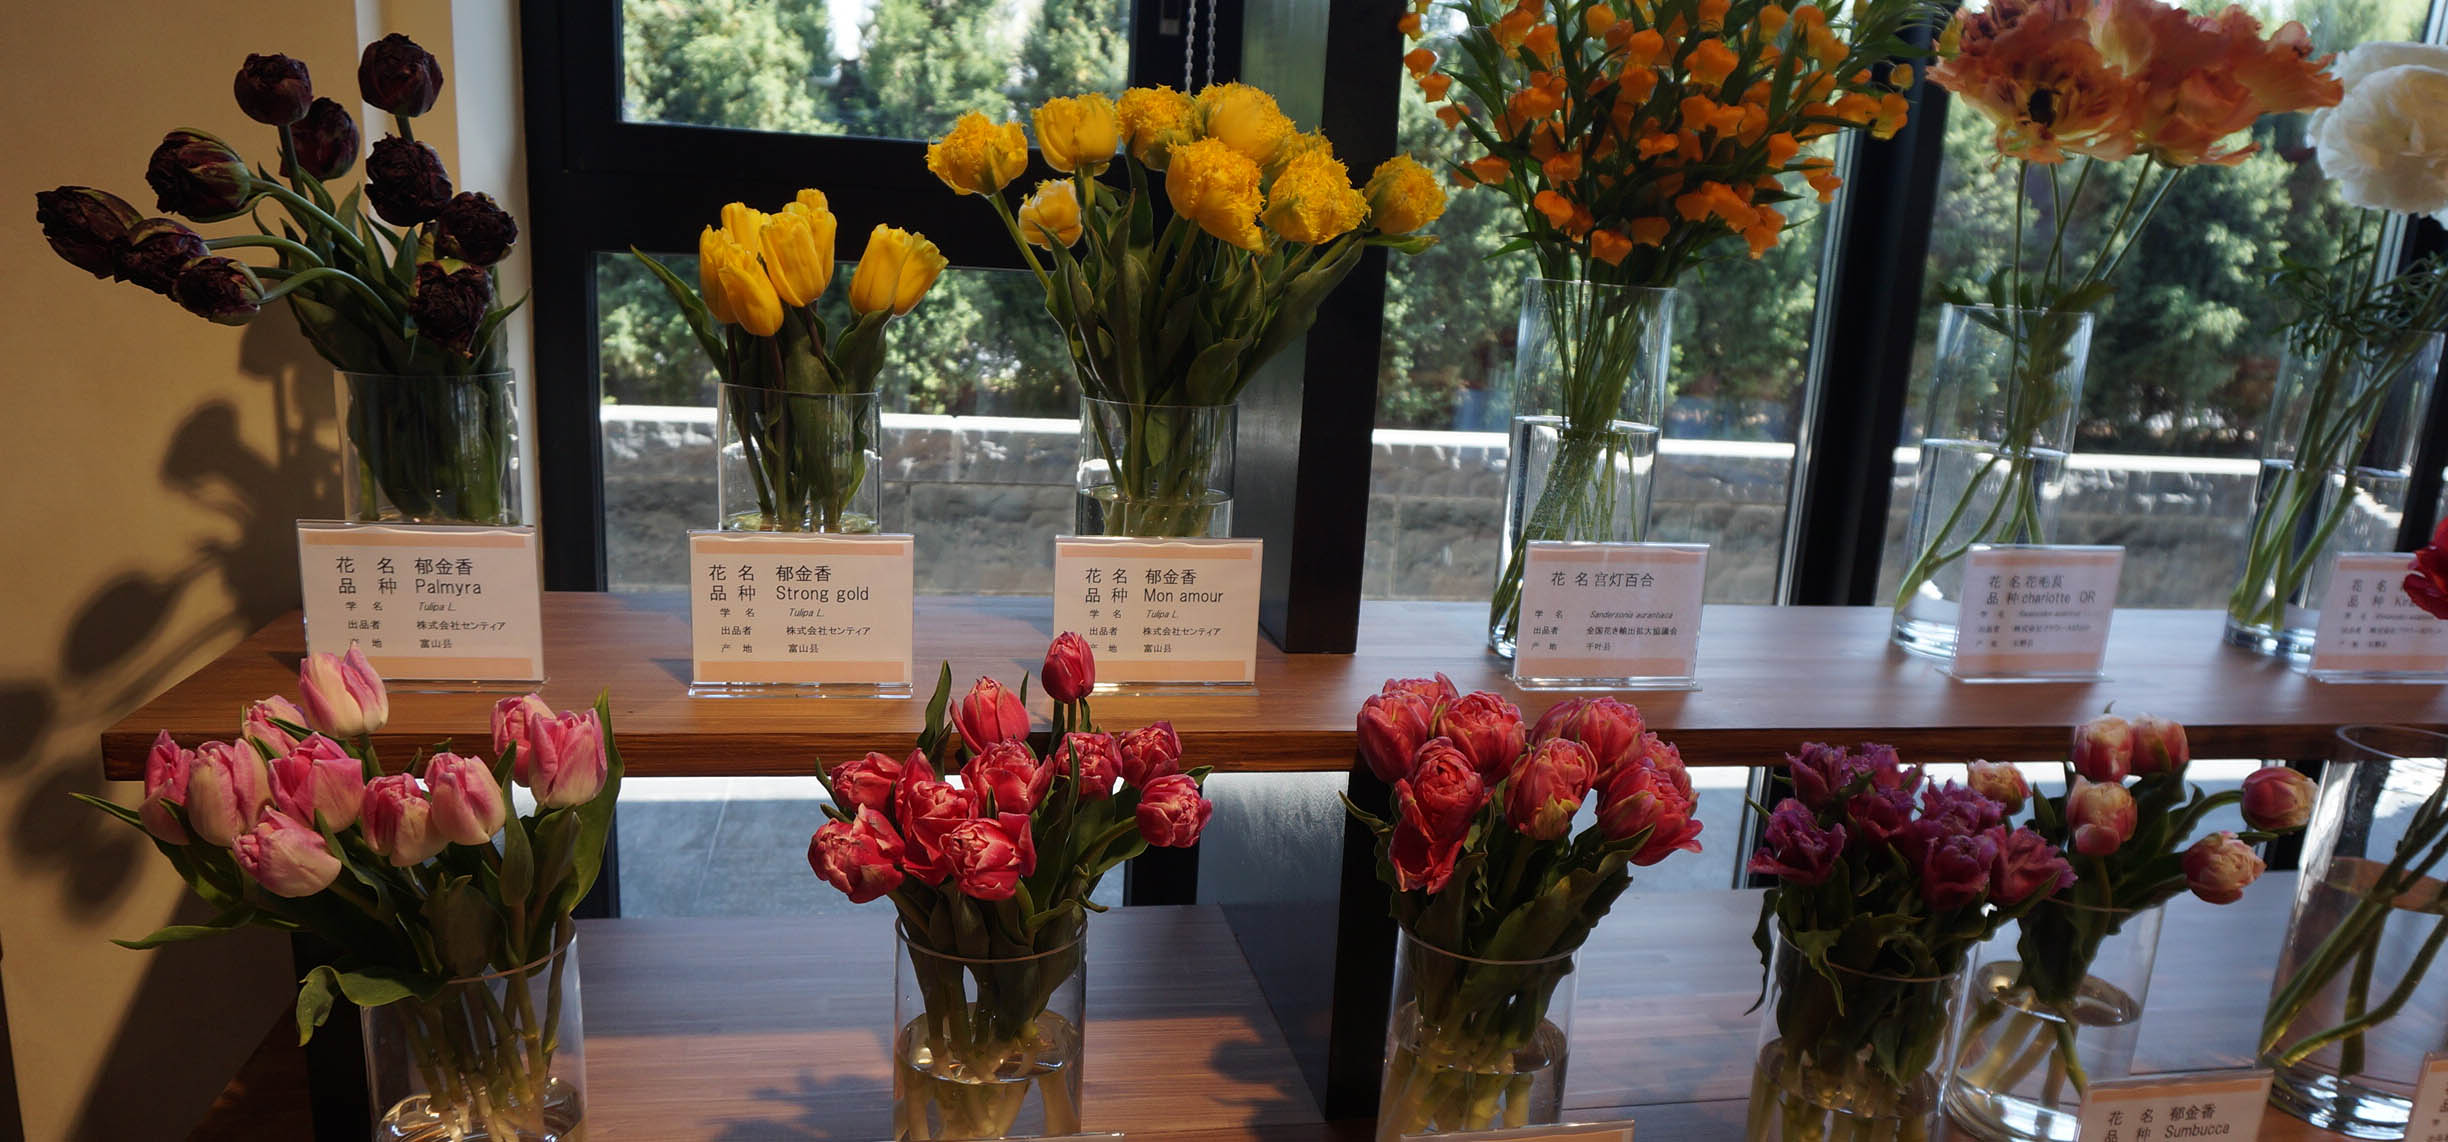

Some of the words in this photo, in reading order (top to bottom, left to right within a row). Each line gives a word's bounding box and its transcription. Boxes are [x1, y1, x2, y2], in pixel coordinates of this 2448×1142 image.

[414, 557, 473, 576] 郁金香
[775, 565, 832, 582] 郁金香
[1145, 568, 1197, 585] 郁金香
[415, 578, 482, 597] Palmyra
[776, 585, 829, 603] Strong
[836, 586, 869, 603] gold
[1144, 588, 1174, 603] Mon
[1179, 590, 1224, 603] amour
[788, 608, 814, 618] Tulipa
[348, 620, 380, 630] 出品者
[416, 620, 506, 631] 株式会社センティア
[721, 626, 752, 636] 出品者
[786, 626, 871, 636] 株式会社センティア
[1089, 627, 1118, 636] 出品者
[1142, 627, 1222, 637] 株式会社センティア
[2169, 1103, 2217, 1121] 郁金香
[2164, 1122, 2230, 1140] Sumbucca
